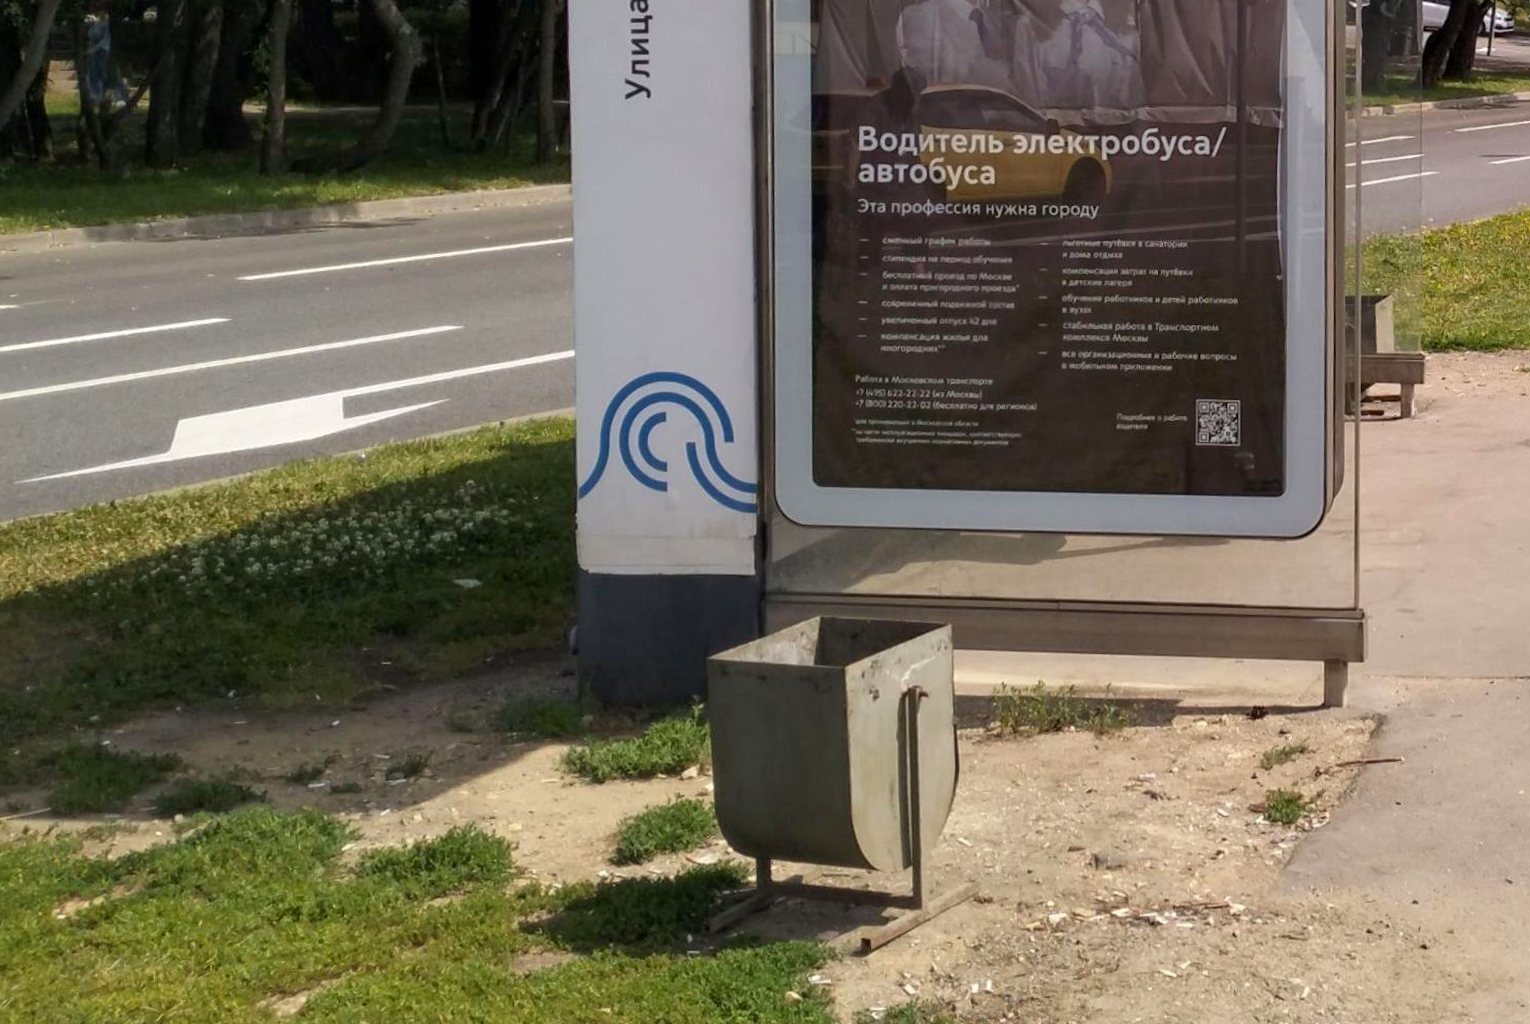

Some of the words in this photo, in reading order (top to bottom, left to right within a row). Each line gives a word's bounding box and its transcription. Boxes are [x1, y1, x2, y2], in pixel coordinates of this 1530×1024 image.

[858, 125, 1004, 156] Водитель
[1013, 126, 1227, 162] электробуса/
[858, 157, 996, 191] автобуса
[857, 199, 887, 214] Эта
[890, 199, 981, 217] профессия
[985, 203, 1037, 219] нужна
[1041, 204, 1099, 220] городу
